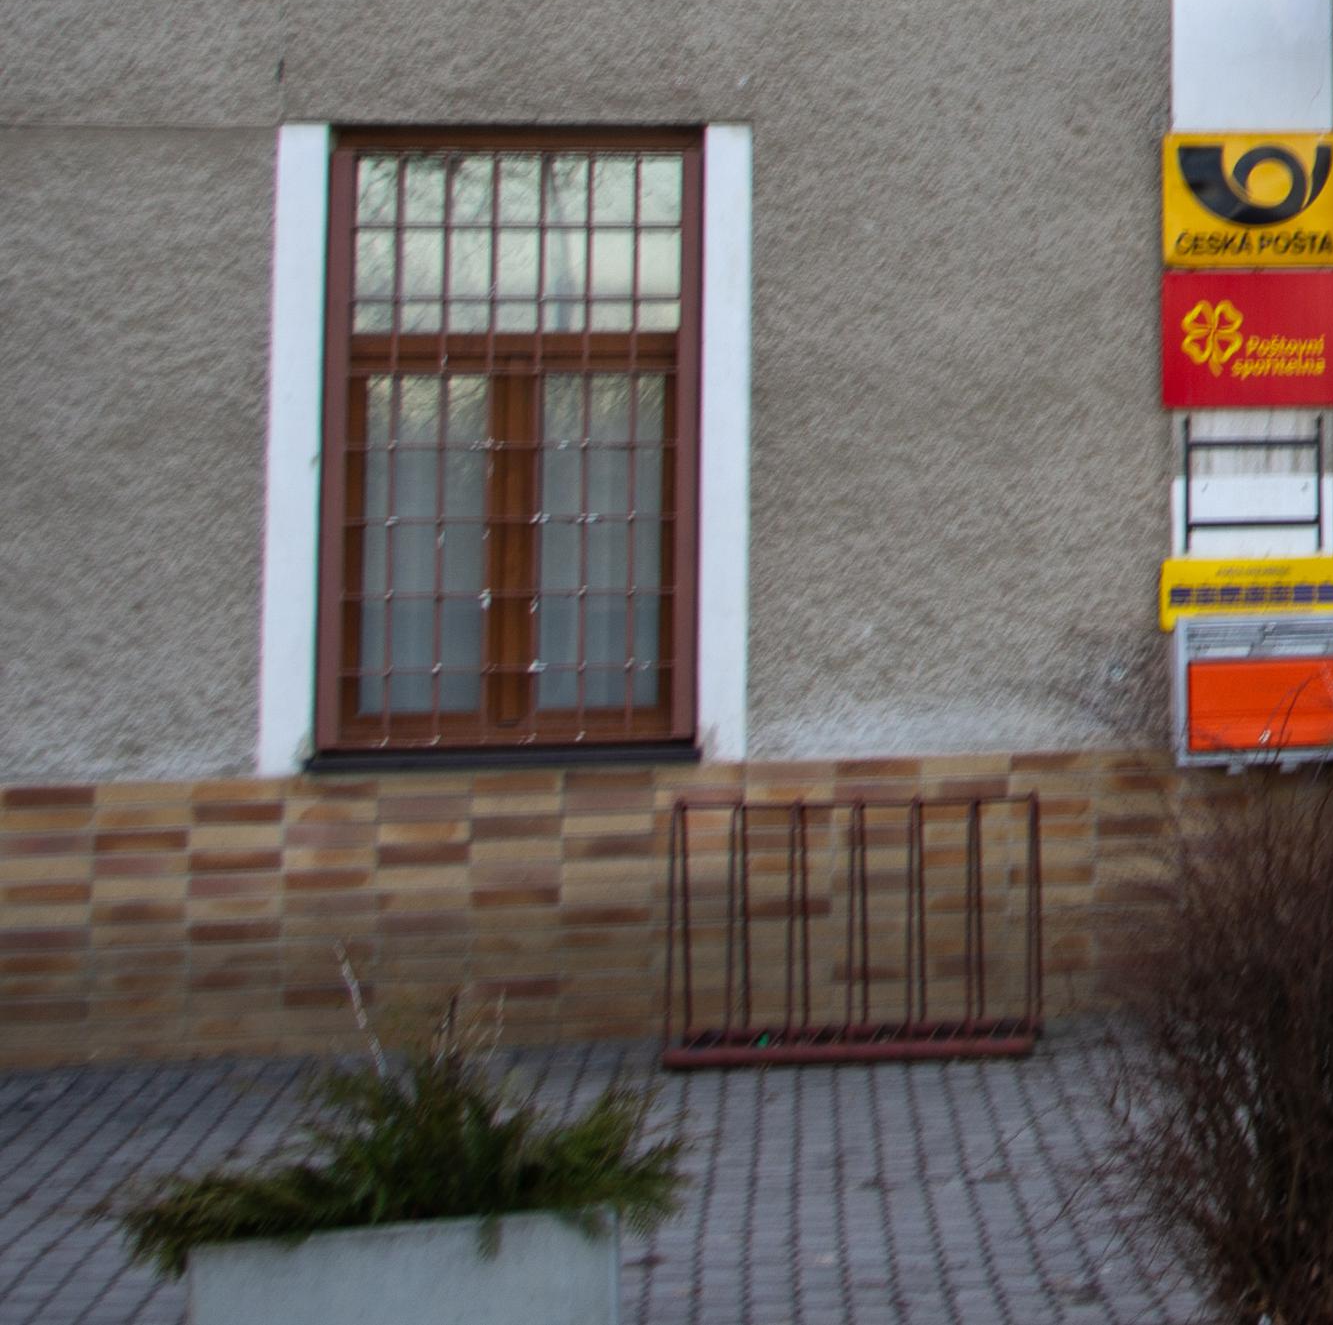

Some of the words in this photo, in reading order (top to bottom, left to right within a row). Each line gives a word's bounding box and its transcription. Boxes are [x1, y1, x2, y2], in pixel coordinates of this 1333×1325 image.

[1175, 229, 1253, 255] ČESKÁ
[1258, 229, 1333, 255] POŠTA
[1245, 332, 1326, 357] Poštovní
[1230, 355, 1326, 382] spořitelna
